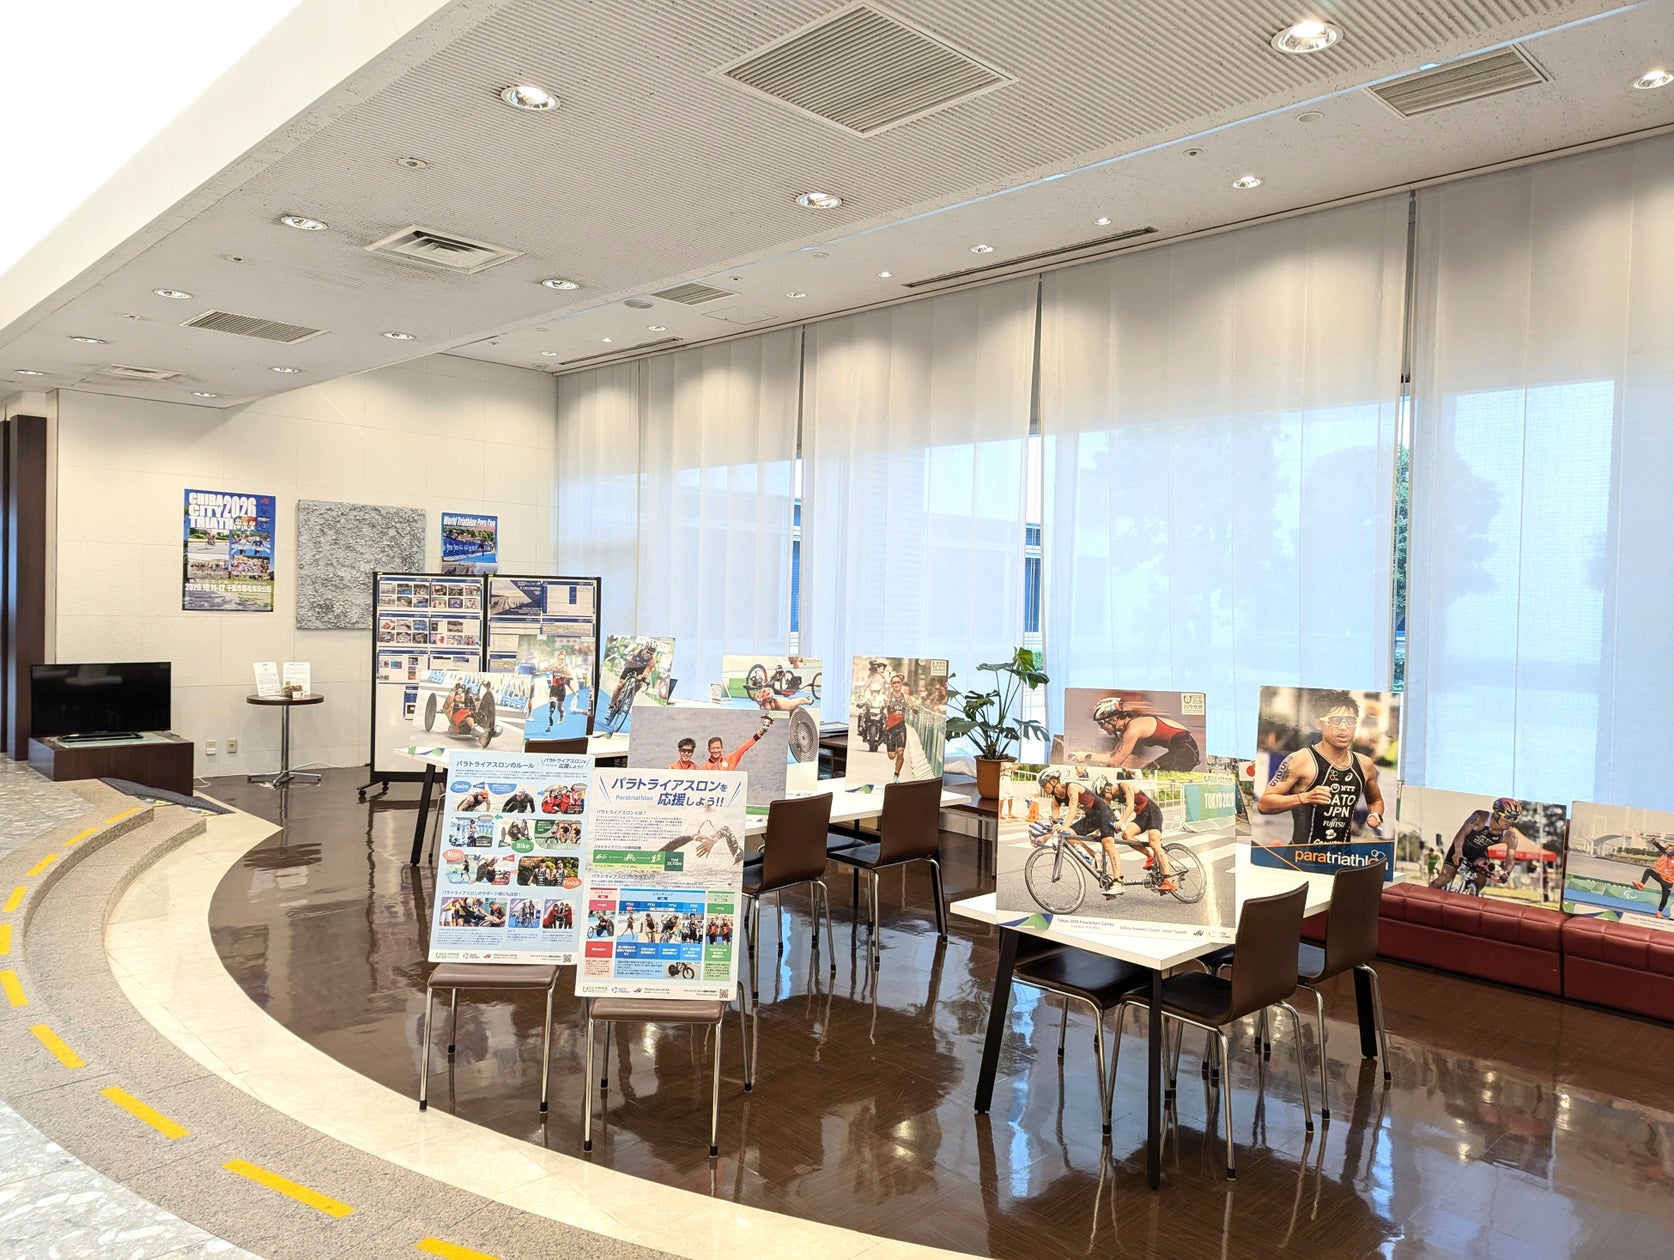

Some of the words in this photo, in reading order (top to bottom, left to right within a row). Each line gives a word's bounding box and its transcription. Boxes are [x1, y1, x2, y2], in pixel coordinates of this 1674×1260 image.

[189, 492, 223, 506] CHIBA
[223, 495, 257, 518] 2026
[189, 504, 224, 517] CITY
[456, 760, 534, 769] パラトライアスロンのルール
[611, 777, 728, 792] パラトライアスロンを
[657, 792, 725, 807] 応援しよう!!
[1323, 806, 1350, 818] JPN
[1322, 818, 1346, 828] FUJITSU
